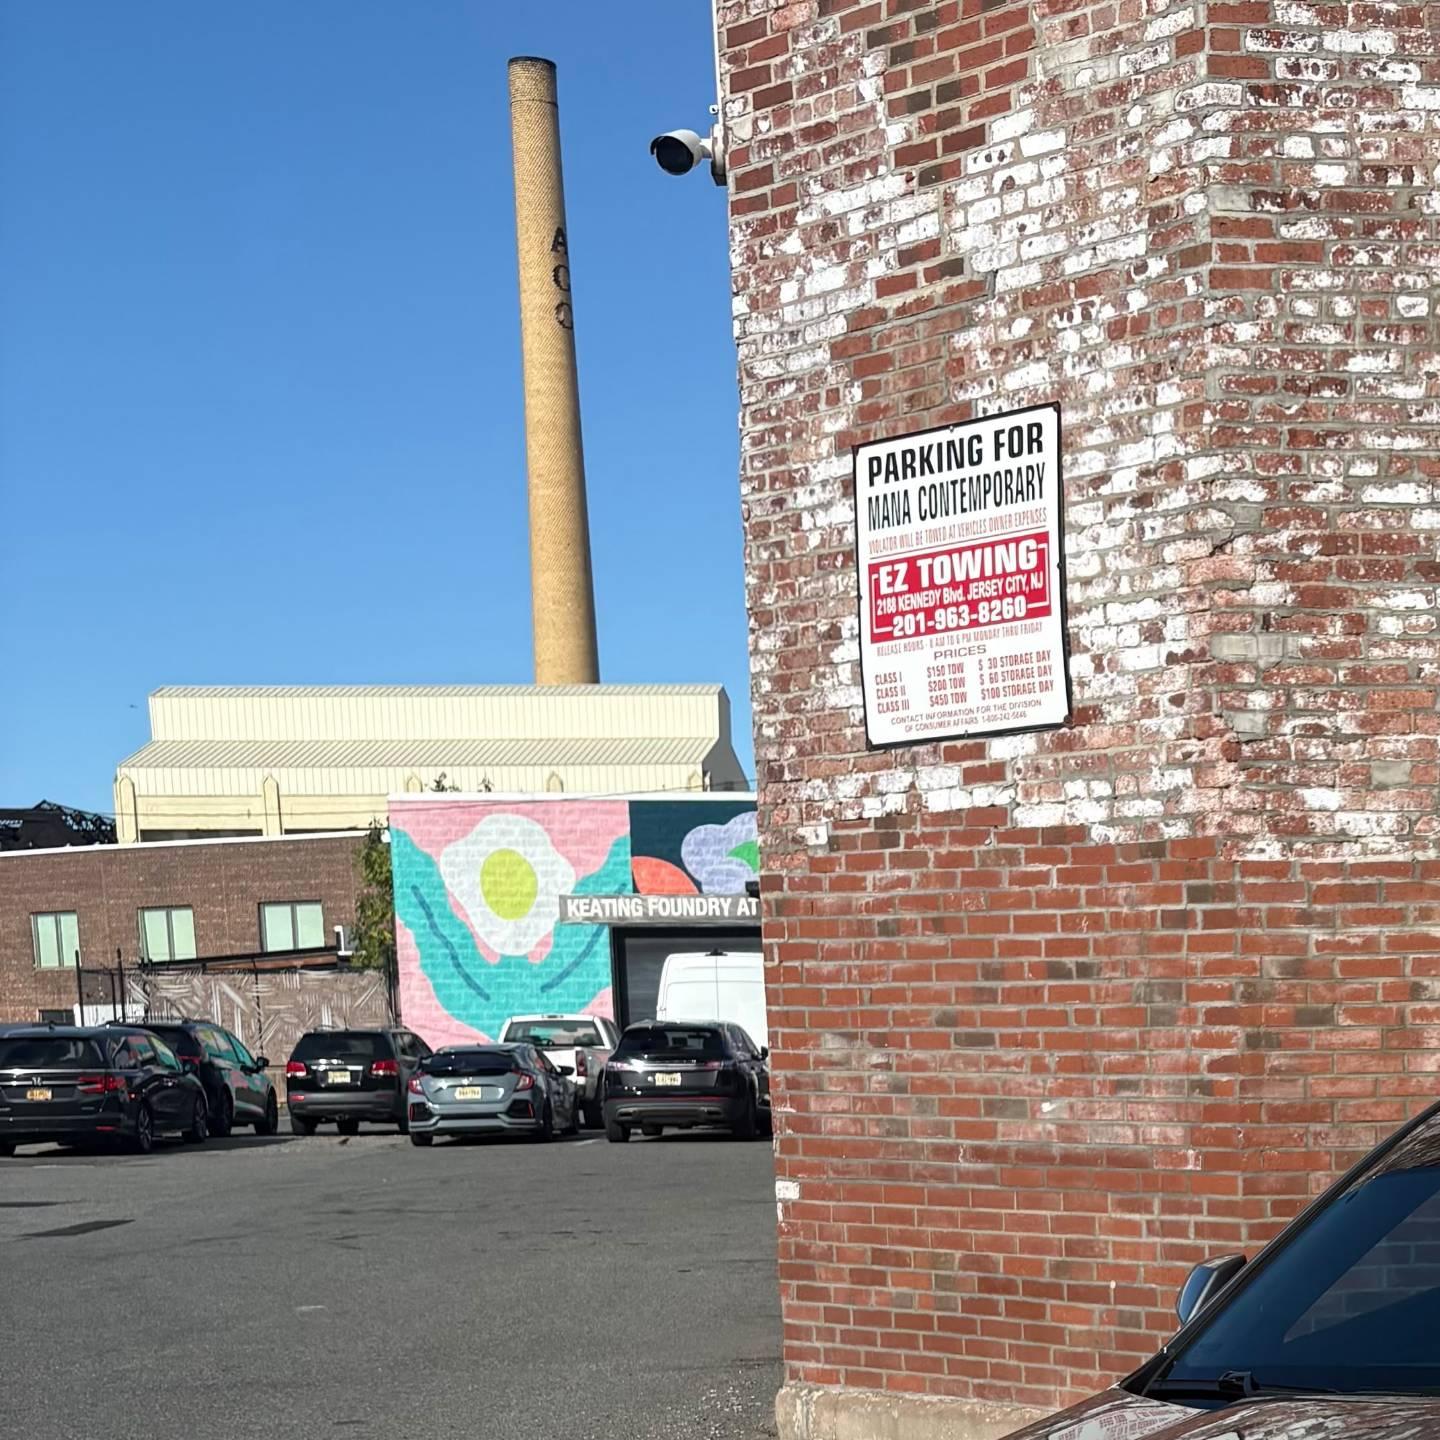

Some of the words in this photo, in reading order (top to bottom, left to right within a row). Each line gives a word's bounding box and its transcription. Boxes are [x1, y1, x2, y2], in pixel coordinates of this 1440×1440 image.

[868, 434, 983, 487] PARKING
[994, 422, 1043, 462] FOR
[868, 489, 911, 532] MANA
[918, 462, 1045, 521] CONTEMPORARY
[868, 535, 897, 554] VIOLATOR
[899, 532, 913, 549] WILL
[915, 530, 923, 546] BE
[925, 526, 946, 544] TOWED
[949, 524, 956, 539] AT
[957, 518, 986, 537] VEHICLES
[989, 514, 1012, 532] OWNER
[1015, 507, 1047, 527] EXPENSES
[879, 562, 909, 595] EZ
[916, 538, 1037, 588] TOWING
[877, 597, 896, 615] 2188
[898, 589, 941, 612] KENNEDY
[943, 585, 965, 605] Blvd.
[967, 578, 1004, 600] JERSEY
[1006, 573, 1029, 594] CITY,
[1031, 571, 1043, 590] NJ
[893, 595, 1026, 637] 201-963-8260
[877, 641, 901, 656] RELEASE
[904, 639, 924, 653] HOURS
[973, 628, 1000, 642] MONDAY
[1002, 625, 1019, 637] THRU
[1020, 621, 1042, 635] FRIDAY
[934, 644, 986, 660] PRICES
[875, 672, 897, 685] CLASS
[899, 671, 903, 682] I
[927, 665, 945, 678] $150
[947, 662, 964, 675] TOW
[988, 657, 997, 670] 30
[1000, 652, 1033, 668] STORAGE
[1036, 650, 1051, 663] DAY
[876, 686, 898, 699] CLASS
[900, 685, 906, 696] II
[928, 679, 947, 692] $200
[949, 677, 965, 689] TOW
[989, 672, 998, 684] 60
[1001, 667, 1035, 682] STORAGE
[1037, 664, 1052, 677] DAY
[877, 700, 899, 714] CLASS
[901, 699, 909, 710] III
[929, 694, 948, 707] $450
[950, 692, 967, 704] TOW
[981, 687, 1000, 700] $100
[1002, 682, 1036, 697] STORAGE
[1039, 680, 1054, 693] DAY
[891, 714, 923, 725] CONTACT
[925, 708, 974, 720] INFORMATION
[976, 704, 991, 714] FOR
[993, 703, 1007, 711] THE
[1009, 699, 1041, 710] DIVISION
[905, 724, 912, 733] OF
[915, 720, 952, 731] CONSUMER
[953, 716, 978, 726] AFFAIRS
[567, 897, 642, 917] KEATING
[649, 898, 730, 918] FOUNDRY
